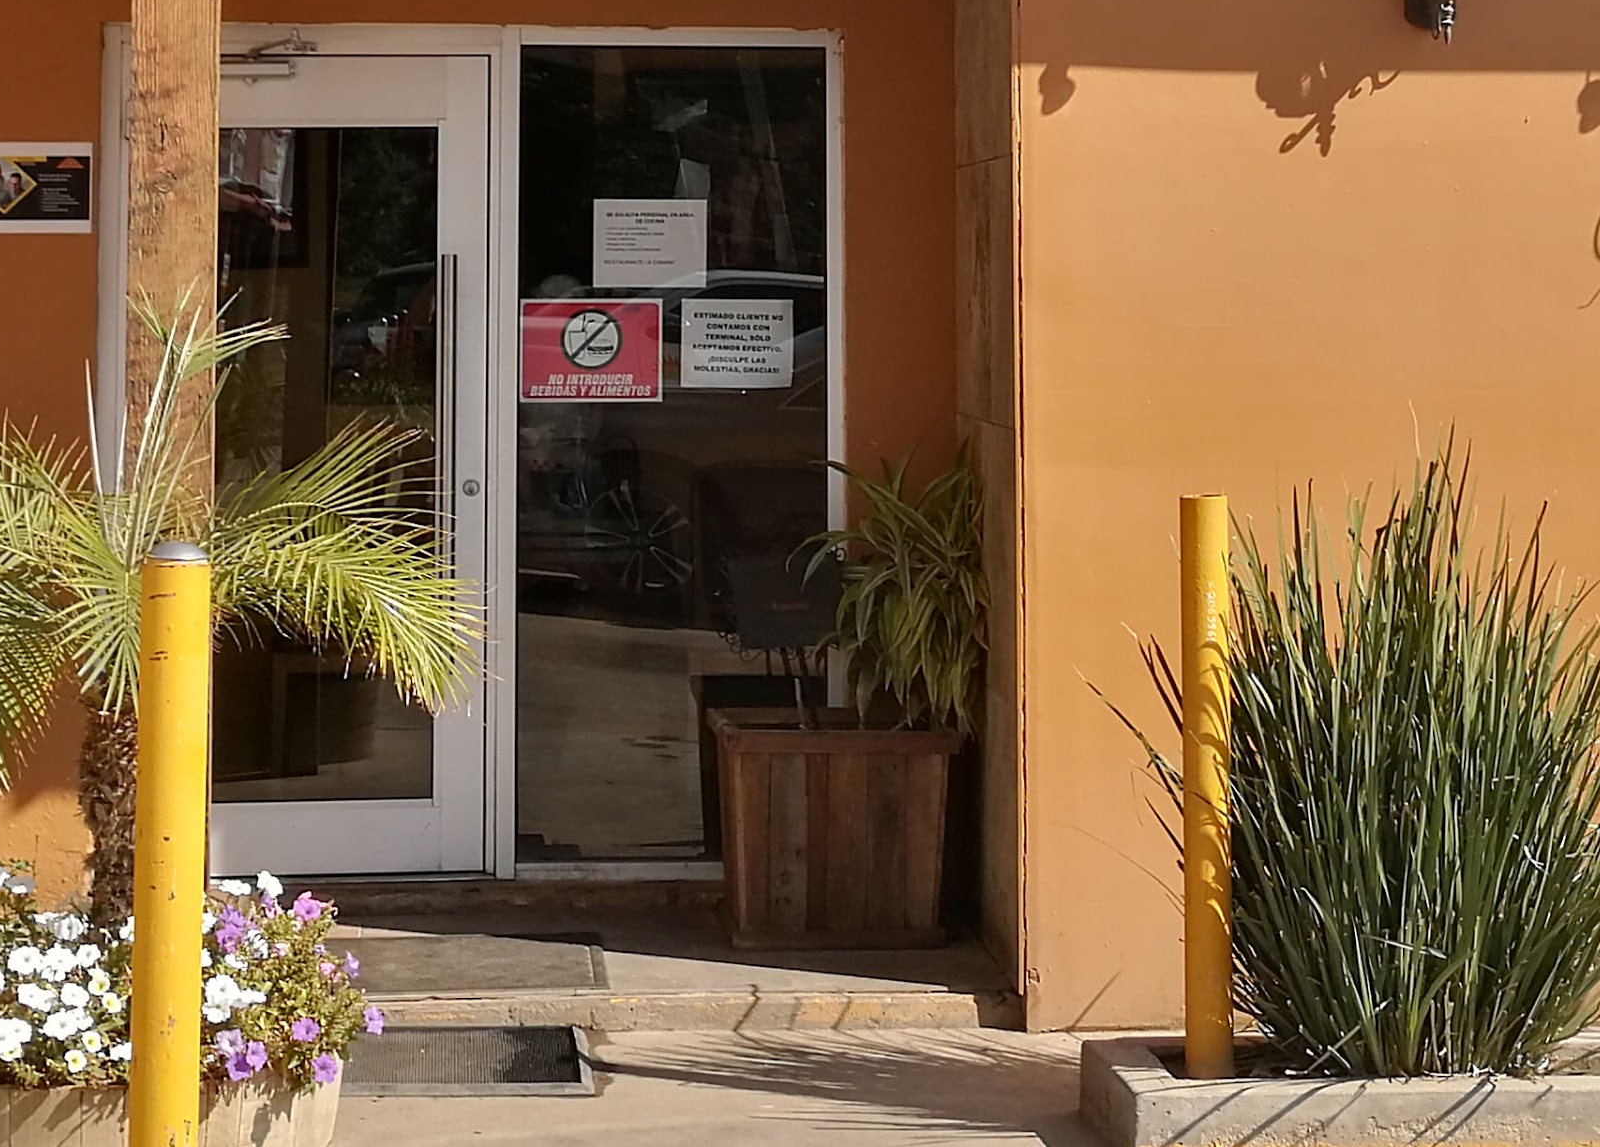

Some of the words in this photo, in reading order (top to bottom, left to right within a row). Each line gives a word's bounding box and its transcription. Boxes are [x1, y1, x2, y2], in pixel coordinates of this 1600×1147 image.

[694, 312, 734, 320] ESTIMADO
[736, 313, 770, 321] CLIENTE
[706, 323, 751, 331] CONTAMOS
[548, 374, 564, 385] NO
[566, 374, 634, 385] INTRODUCIR
[530, 385, 577, 396] BEBIDAS
[580, 386, 587, 396] Y
[589, 385, 651, 396] ALIMENTOS
